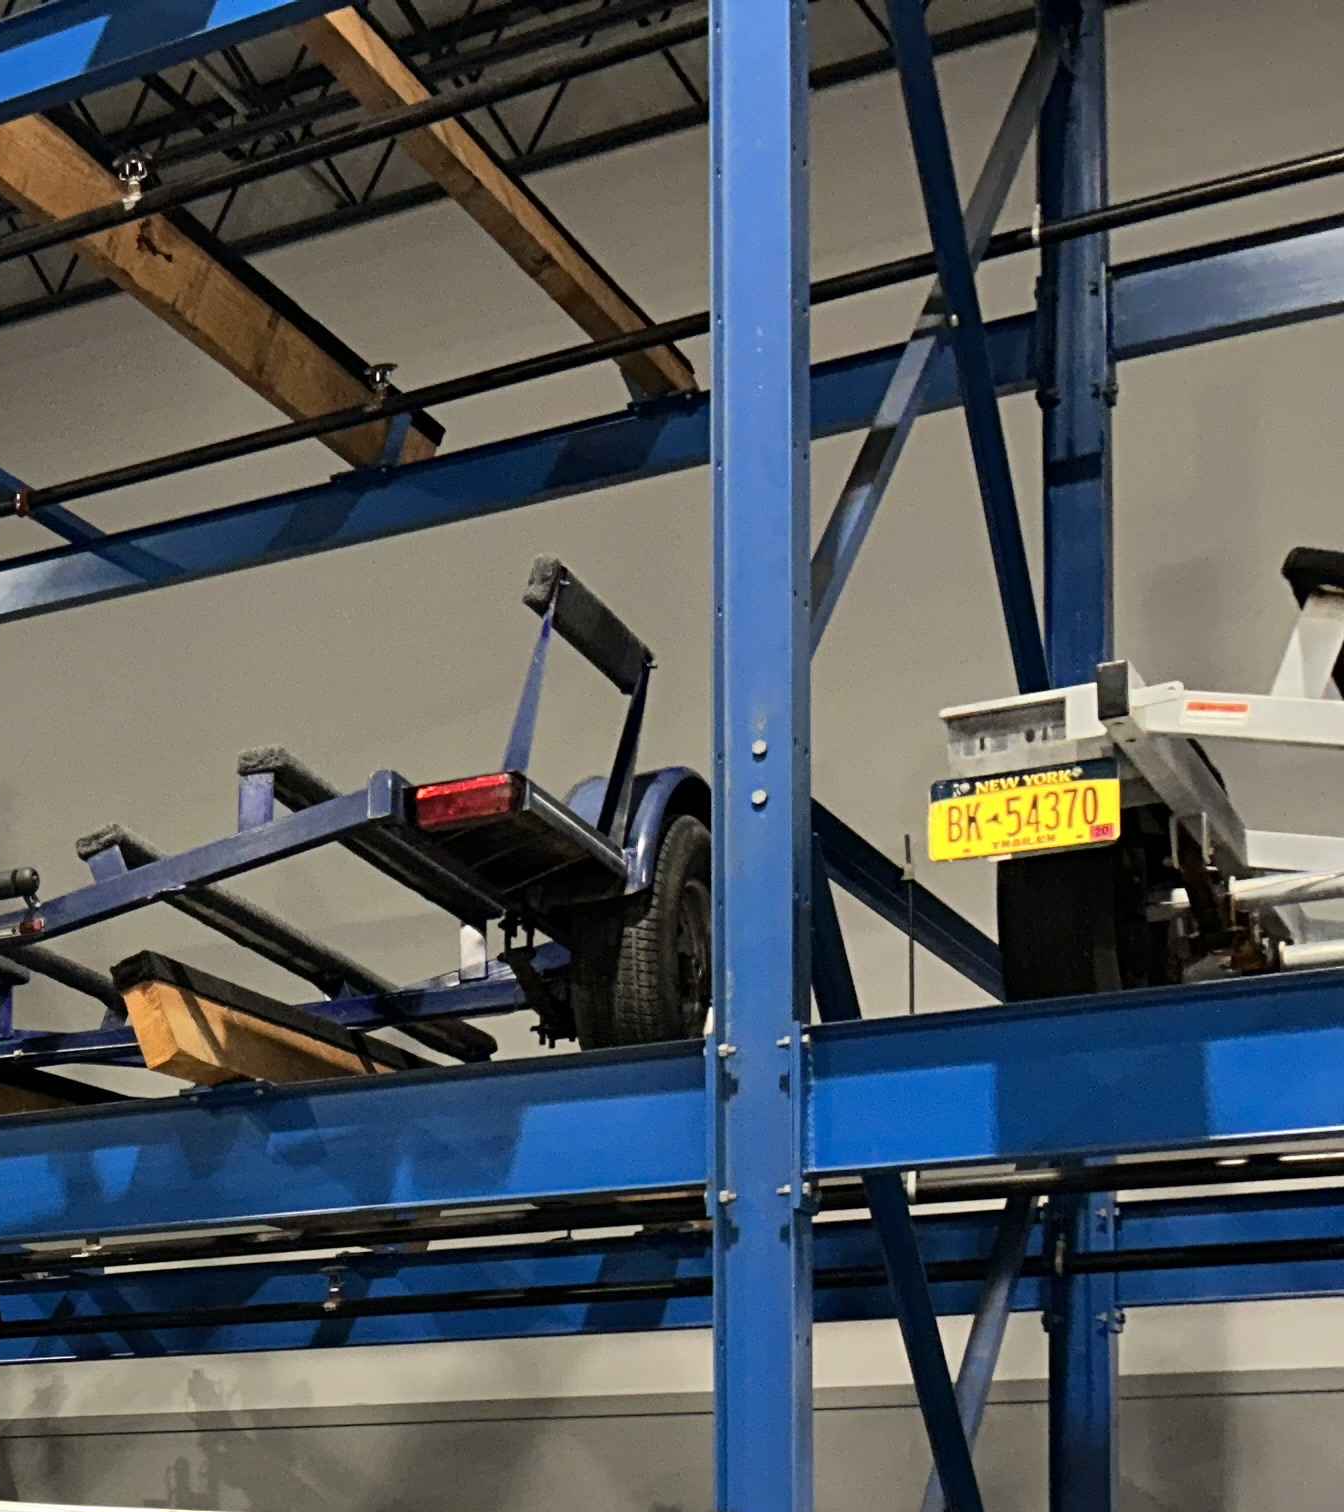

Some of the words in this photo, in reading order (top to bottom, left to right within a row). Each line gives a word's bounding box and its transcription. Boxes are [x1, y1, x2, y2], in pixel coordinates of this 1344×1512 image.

[974, 775, 1019, 795] NEW
[1022, 767, 1073, 788] YORK
[947, 802, 982, 843] BK
[1005, 786, 1099, 836] 54370
